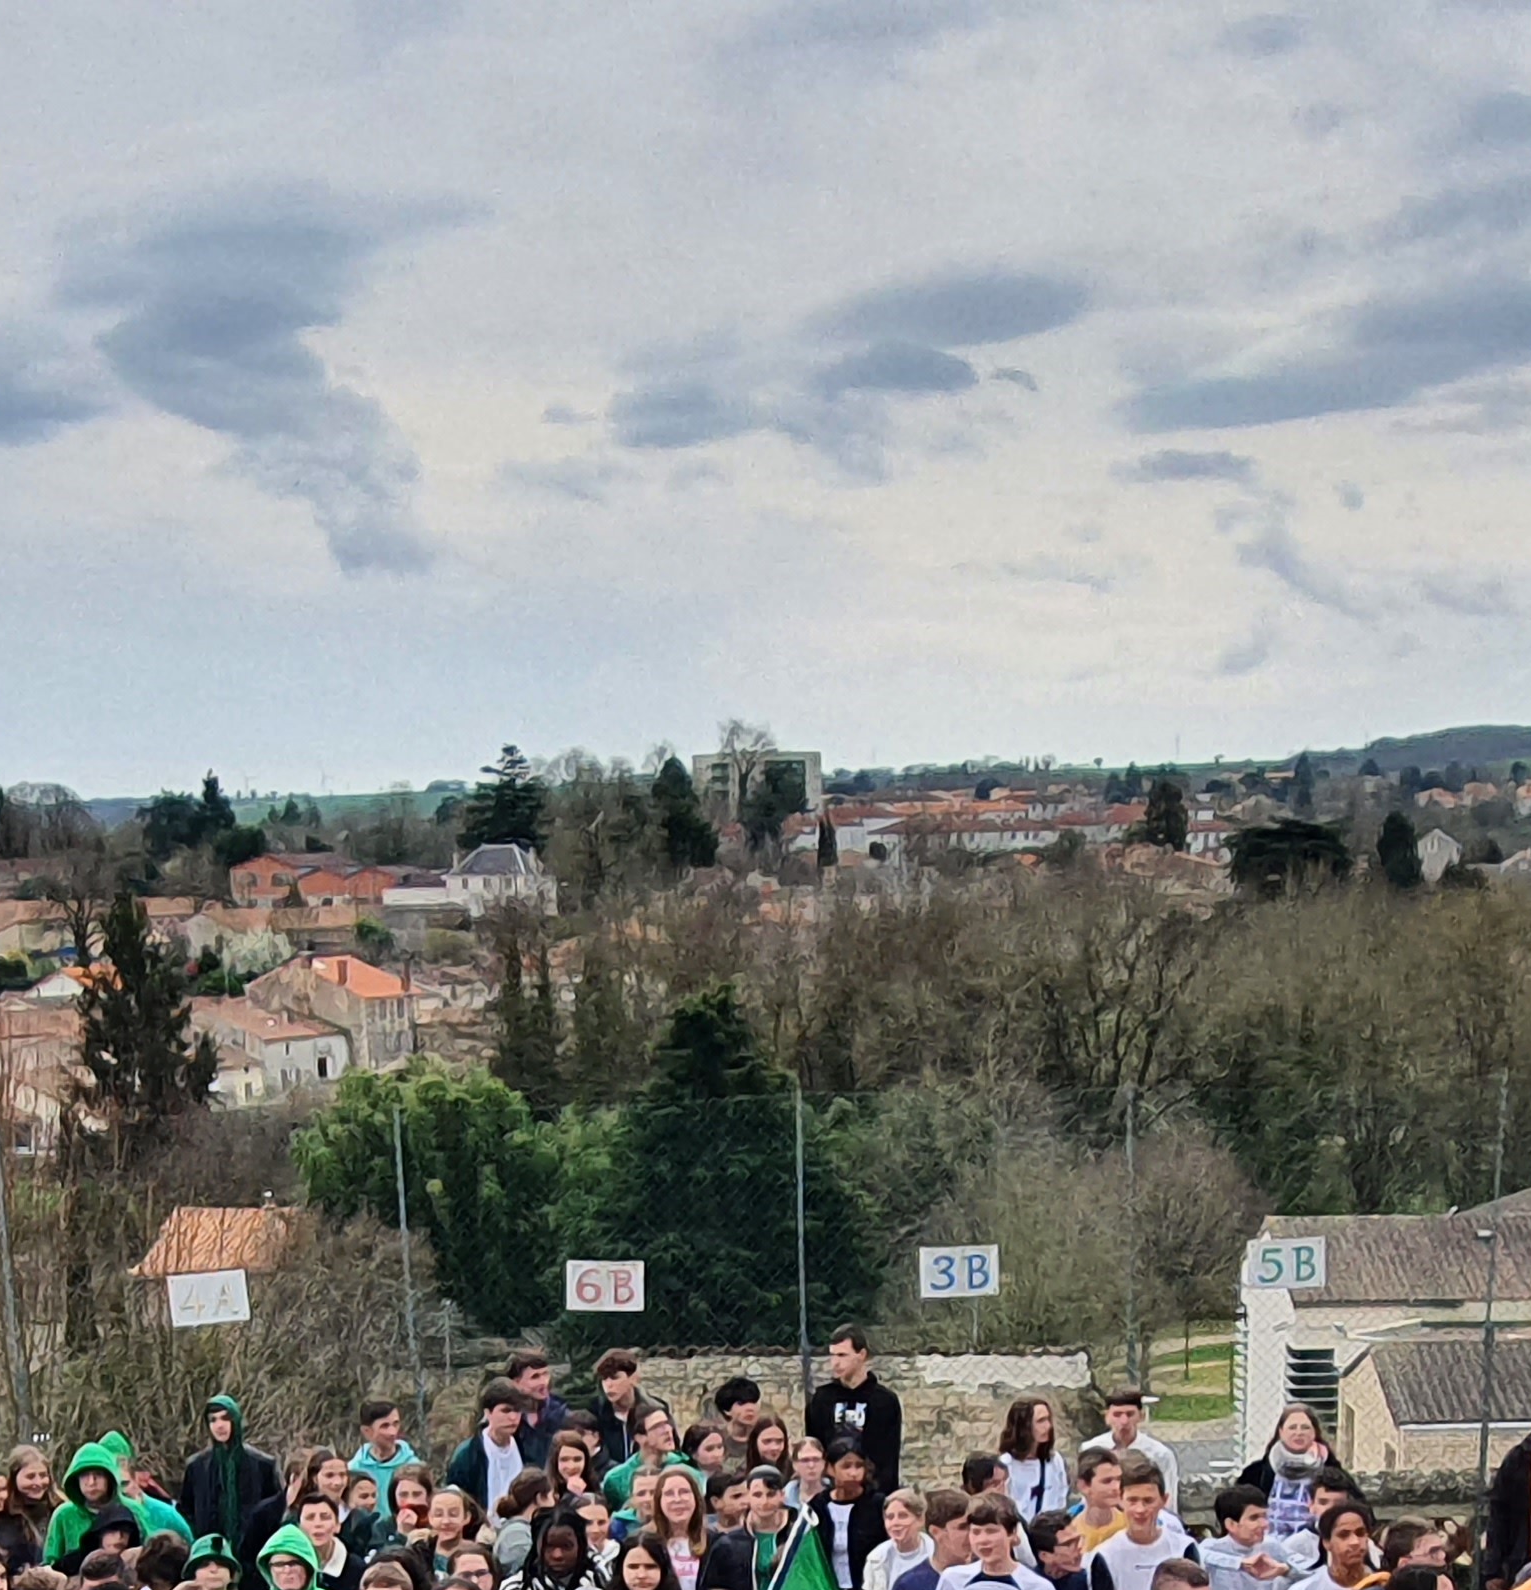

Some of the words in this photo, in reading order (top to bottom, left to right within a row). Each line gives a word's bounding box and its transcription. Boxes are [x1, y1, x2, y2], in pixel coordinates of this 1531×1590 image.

[929, 1254, 991, 1291] 3B
[1257, 1245, 1317, 1283] 5B
[575, 1268, 636, 1304] 6B
